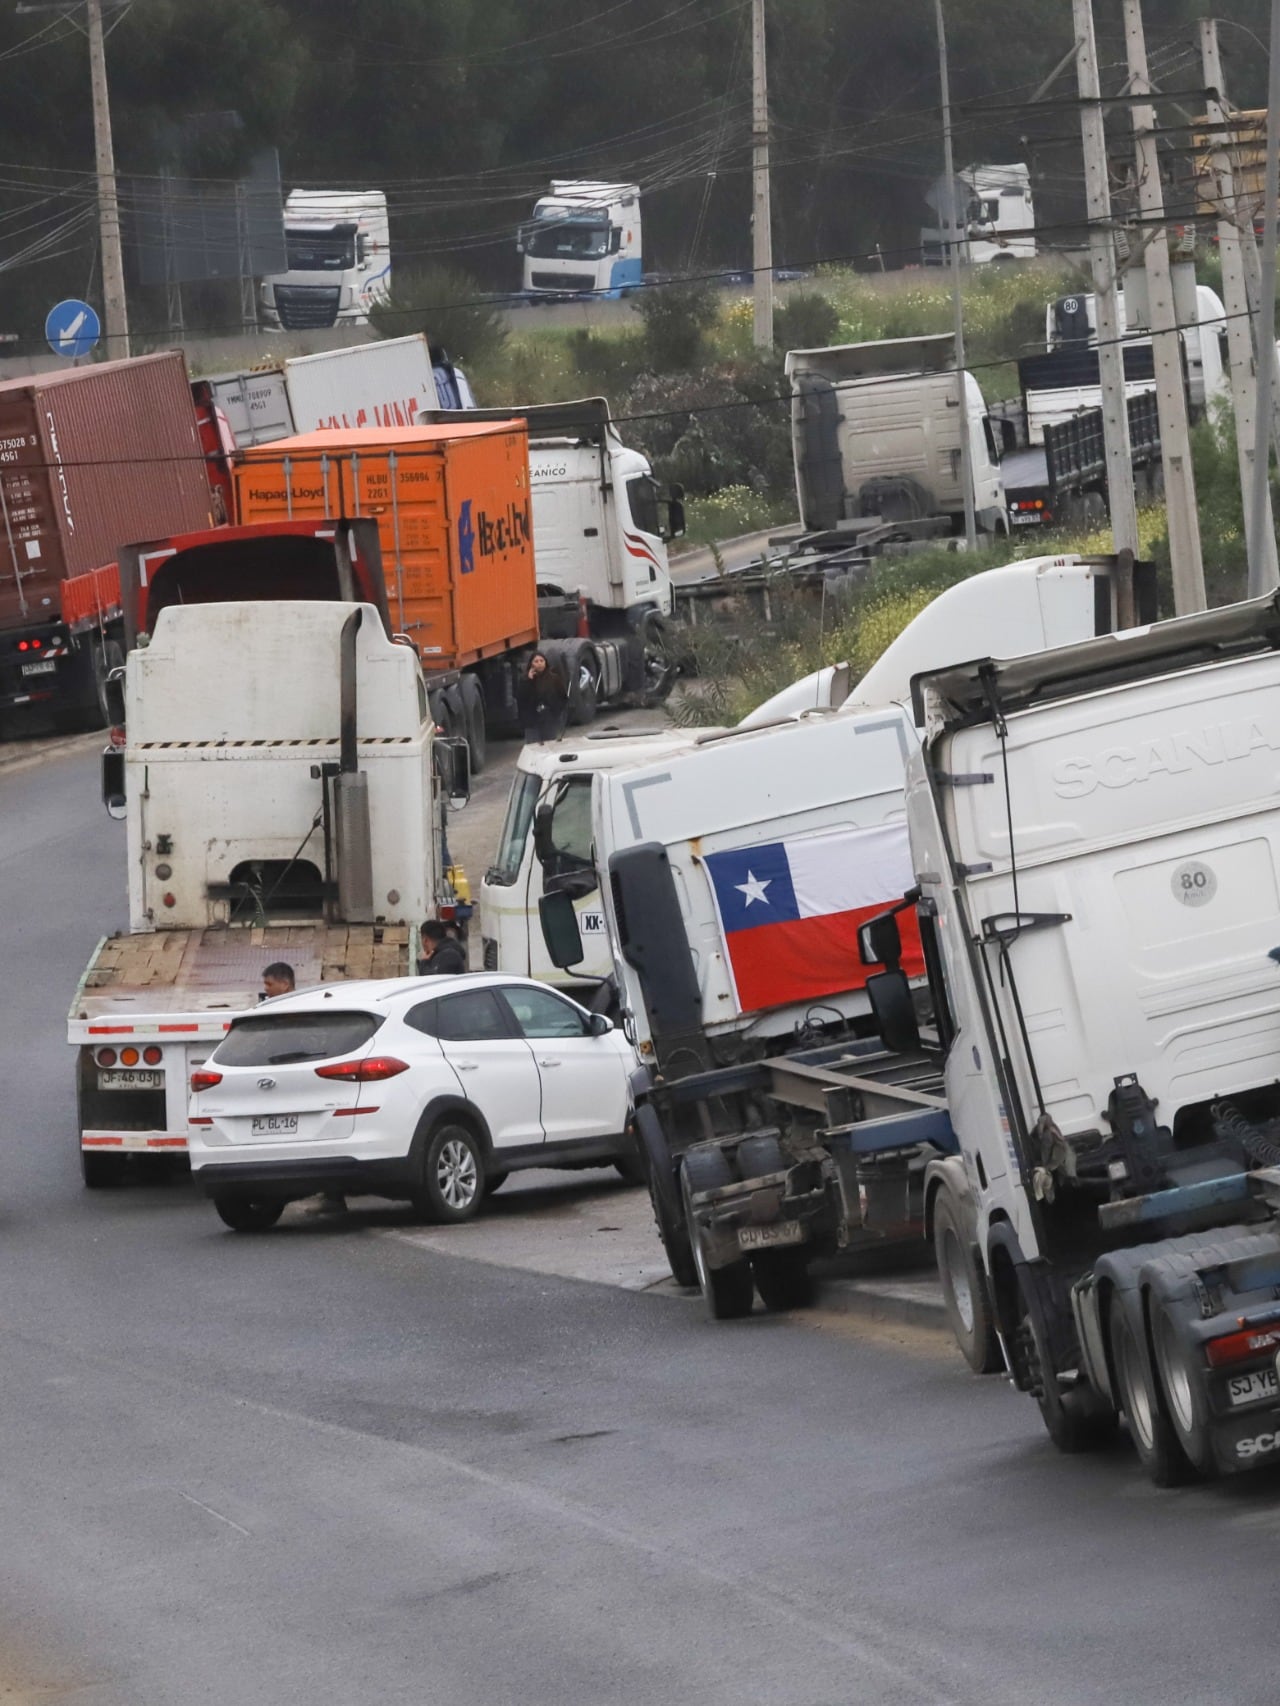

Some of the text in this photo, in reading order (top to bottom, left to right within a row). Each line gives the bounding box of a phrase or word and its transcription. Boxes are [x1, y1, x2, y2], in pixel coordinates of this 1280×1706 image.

[1065, 301, 1077, 311] 80
[30, 435, 37, 445] 3
[1, 451, 18, 462] 45G1
[528, 467, 566, 478] EANICO
[1181, 871, 1207, 890] 80
